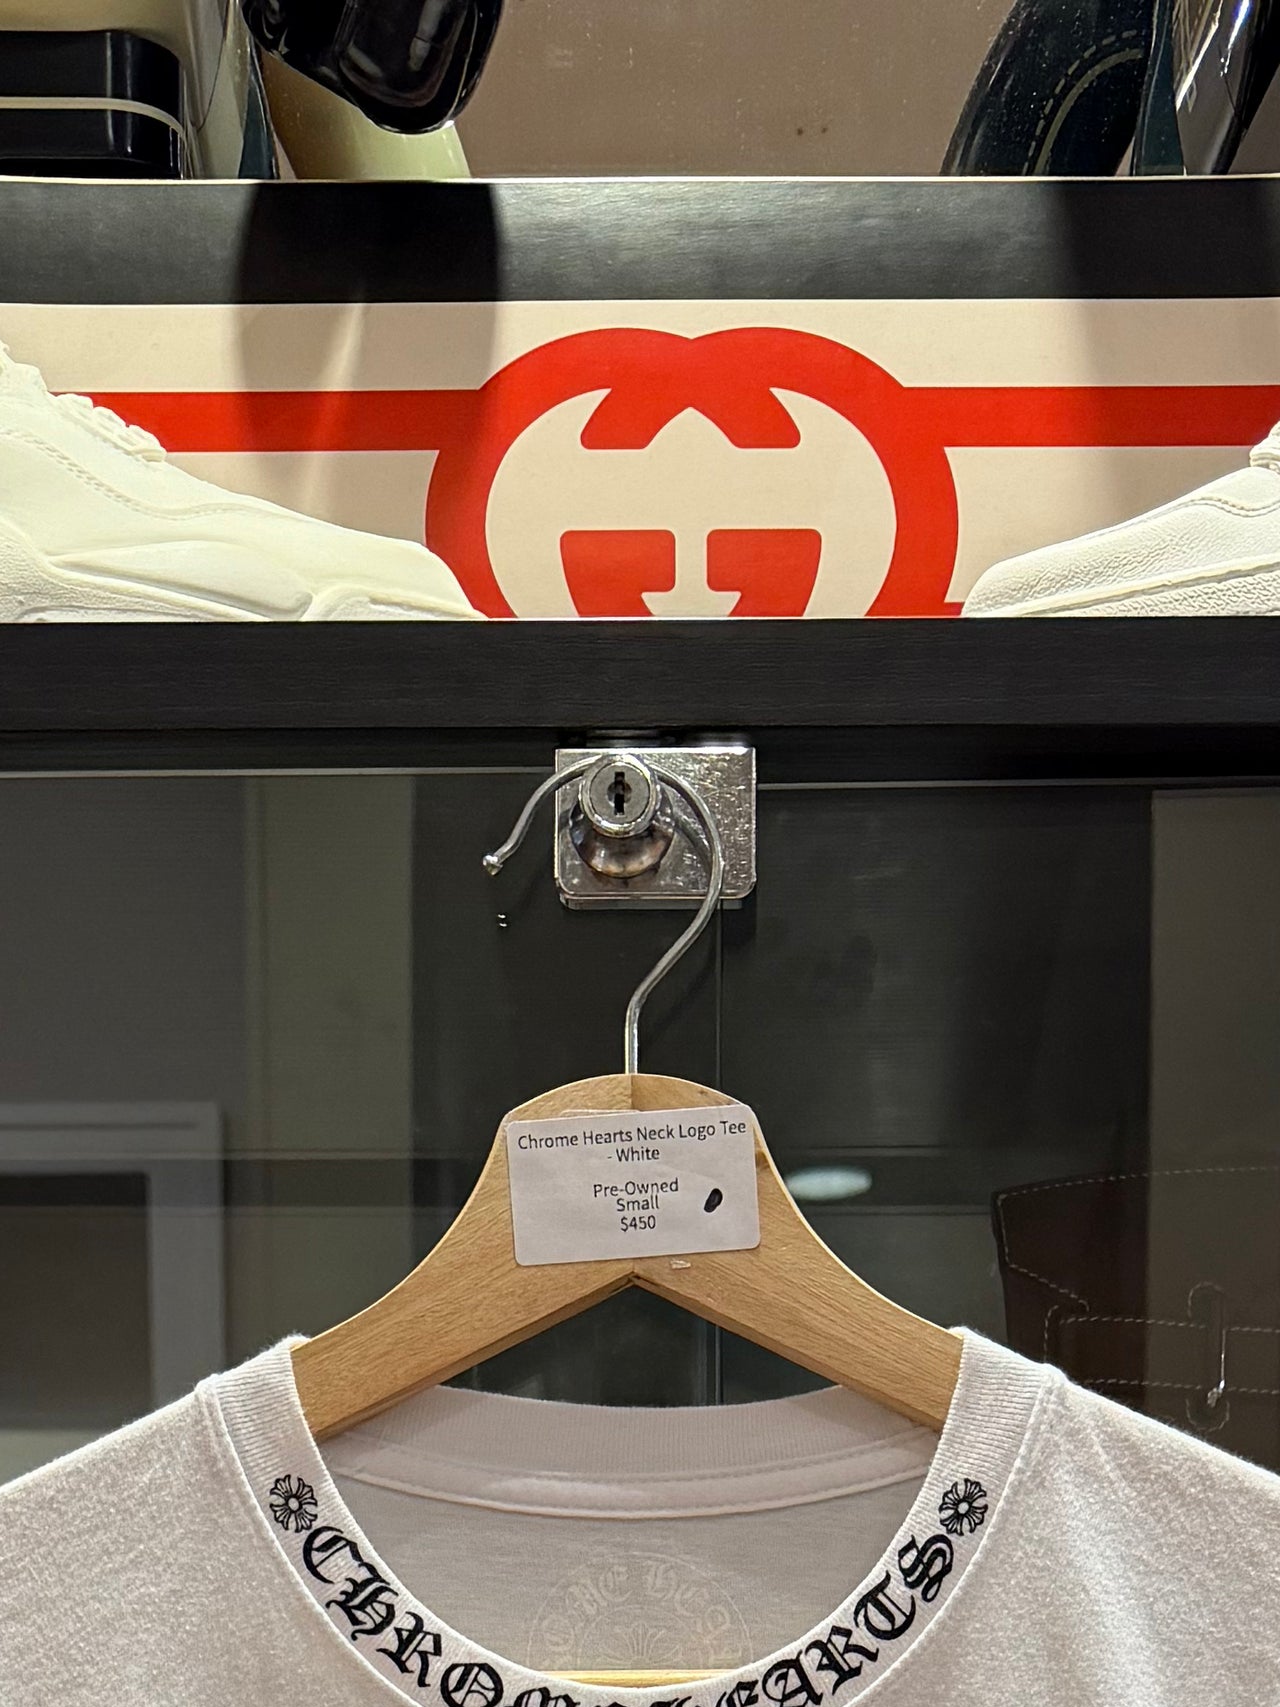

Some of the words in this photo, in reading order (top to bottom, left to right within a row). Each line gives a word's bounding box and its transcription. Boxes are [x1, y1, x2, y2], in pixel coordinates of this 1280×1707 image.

[517, 1133, 579, 1150] Chrome
[582, 1128, 634, 1145] Hearts
[636, 1124, 675, 1141] Neck
[678, 1122, 717, 1141] Logo
[719, 1119, 747, 1135] Tee
[615, 1145, 661, 1162] White
[593, 1176, 679, 1198] Pre-Owned
[616, 1193, 660, 1212] Small
[620, 1214, 656, 1233] $450
